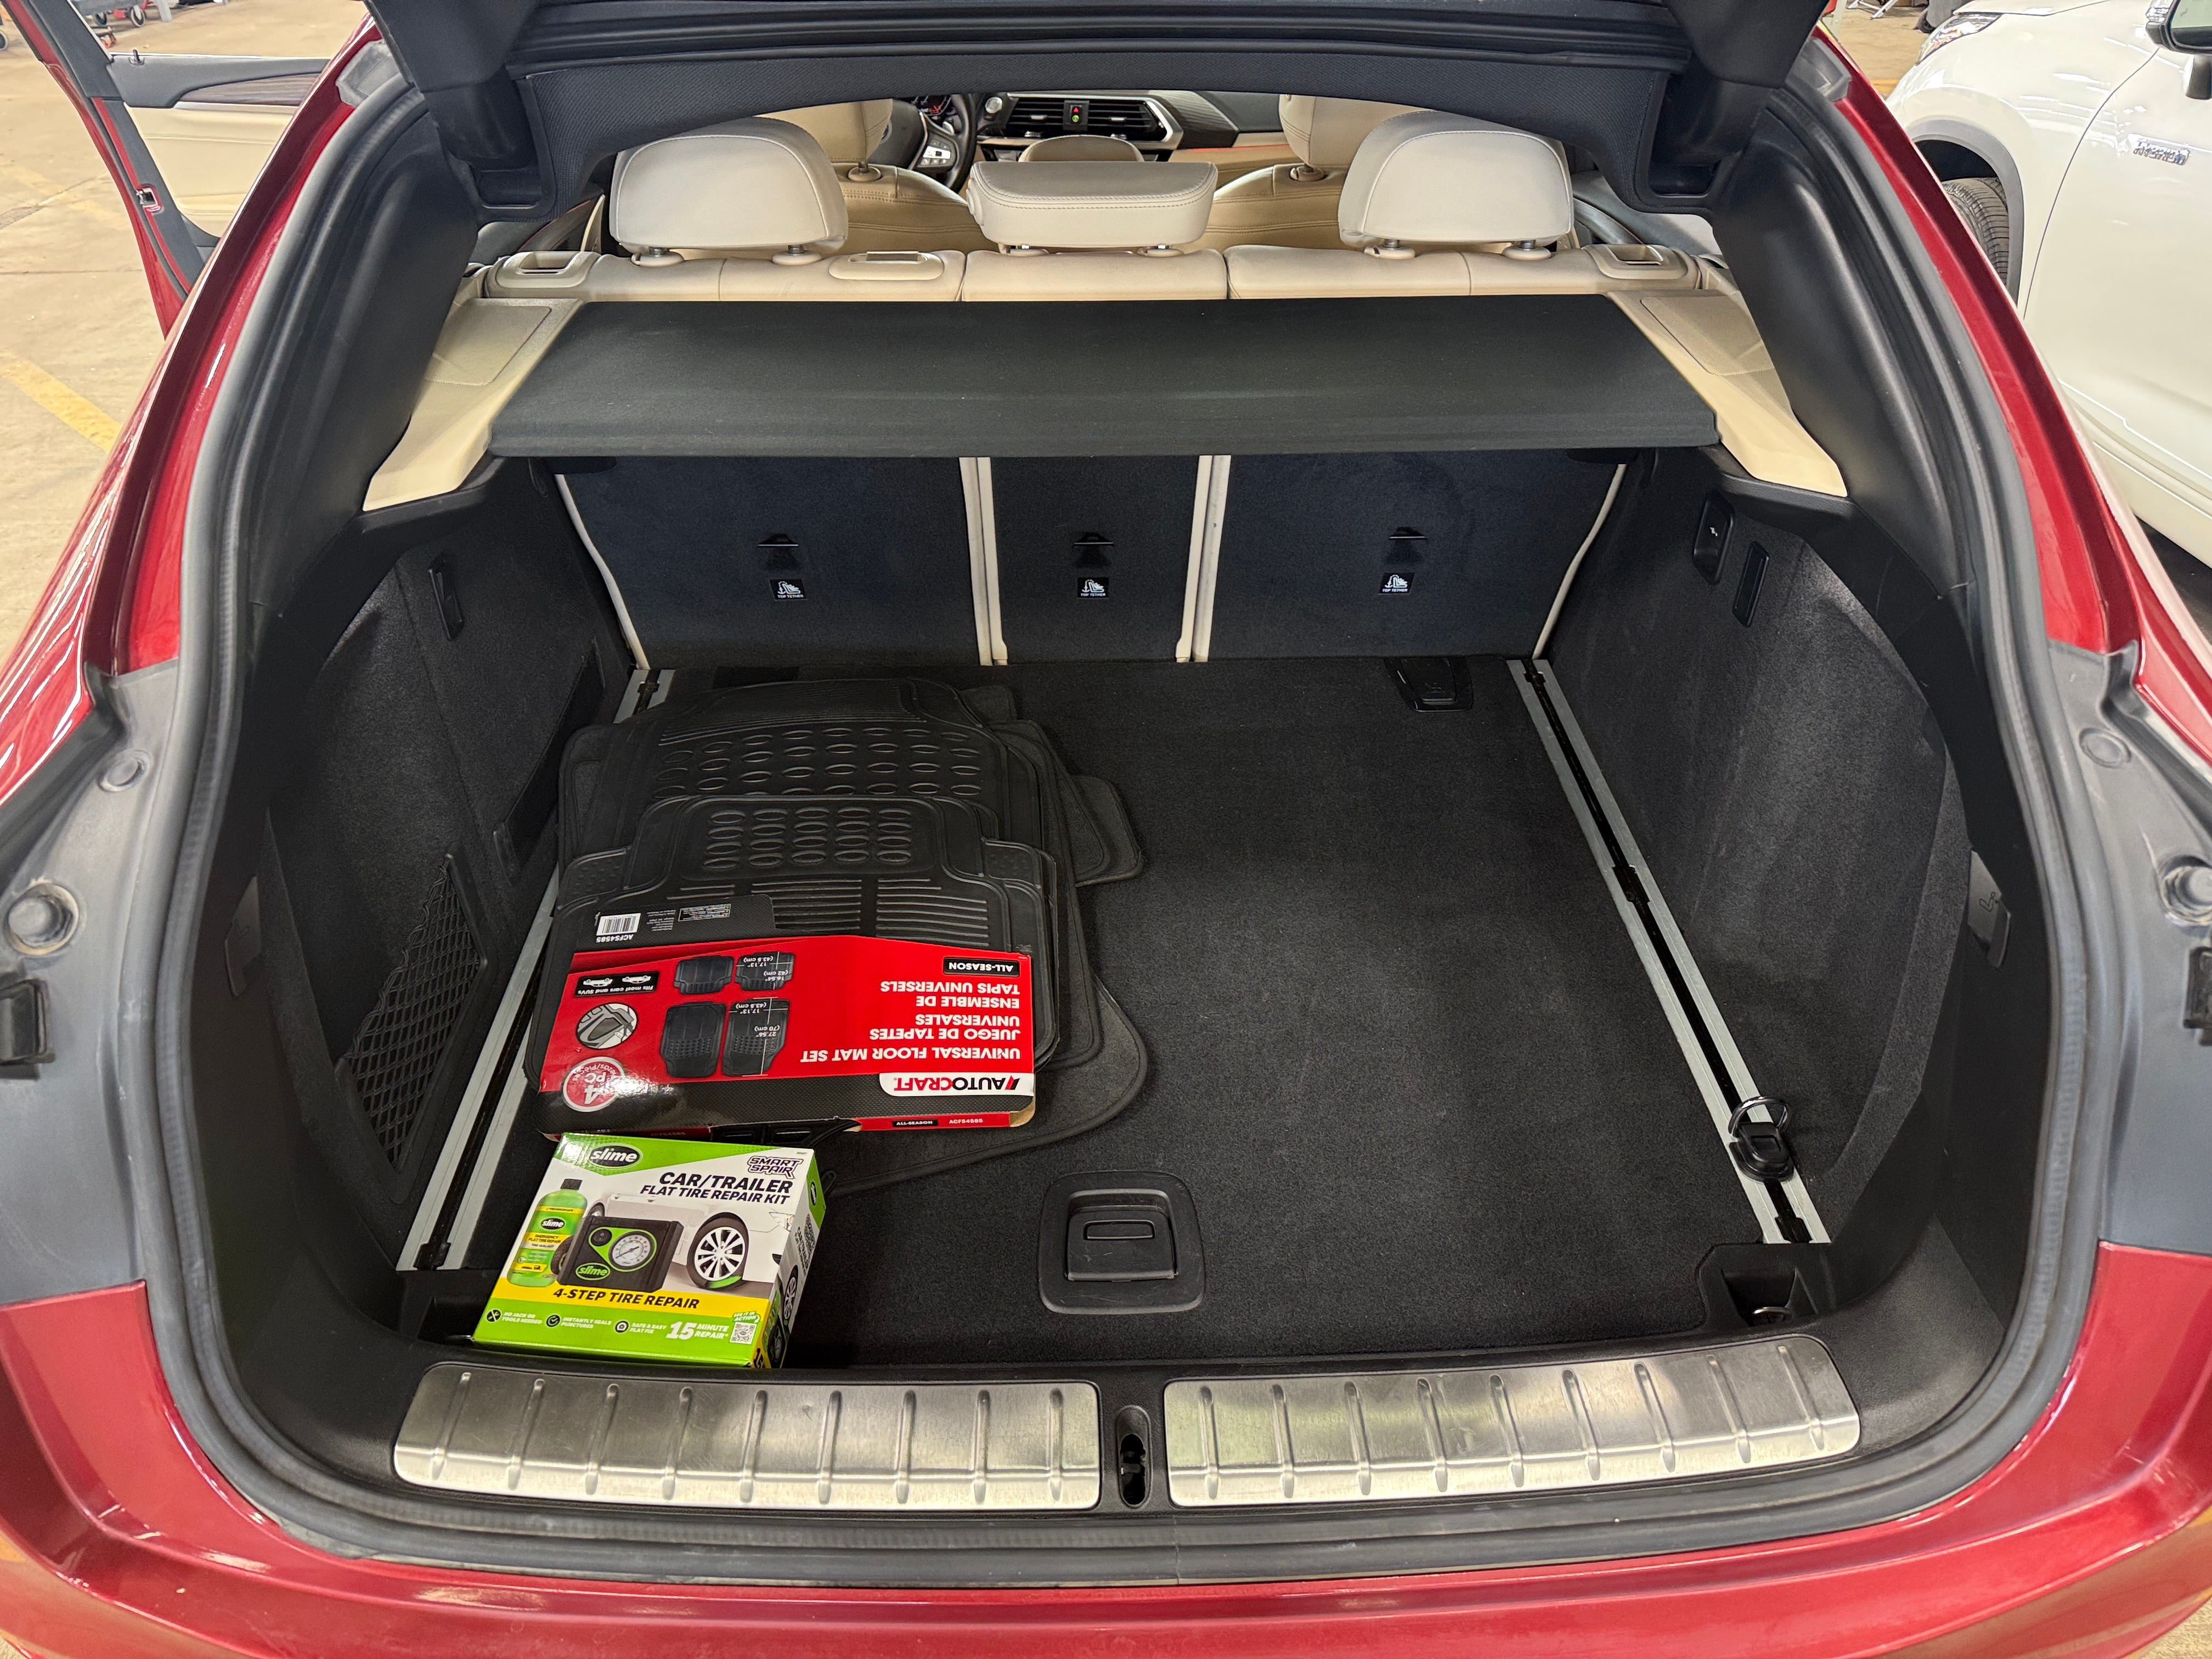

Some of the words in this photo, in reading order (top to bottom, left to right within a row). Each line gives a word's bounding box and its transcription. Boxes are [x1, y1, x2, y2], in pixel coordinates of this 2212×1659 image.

[596, 934, 634, 943] ACFS4585
[948, 962, 1014, 972] ALL-SEASON
[880, 981, 973, 994] UNIVERSELS
[977, 983, 1020, 995] TAPIS
[916, 996, 936, 1007] DE
[941, 996, 1020, 1009] ENSEMBLE
[915, 1014, 1020, 1027] UNIVERSALES
[869, 1028, 935, 1040] TAPETES
[938, 1028, 960, 1040] DE
[963, 1029, 1022, 1041] JUEGO
[800, 1050, 828, 1063] SET
[832, 1048, 868, 1062] MAT
[872, 1047, 927, 1060] FLOOR
[931, 1047, 1021, 1060] UNIVERSAL
[584, 1072, 607, 1083] PC
[893, 1076, 1006, 1091] AUTOCRAFT
[584, 1085, 601, 1104] 4
[590, 1146, 637, 1163] slime
[749, 1158, 800, 1166] SMART
[750, 1165, 793, 1177] SPAIR
[659, 1172, 794, 1194] CAR/TRAILER
[640, 1185, 680, 1196] FLAT
[679, 1187, 709, 1198] TIRE
[713, 1190, 763, 1202] REPAIR
[765, 1193, 791, 1205] KIT
[541, 1219, 564, 1228] slime
[578, 1265, 608, 1276] slime
[553, 1288, 606, 1301] 4-STEP
[608, 1292, 644, 1305] TIRE
[644, 1295, 700, 1309] REPAIR
[665, 1321, 697, 1340] 15
[697, 1323, 729, 1332] MINUTE
